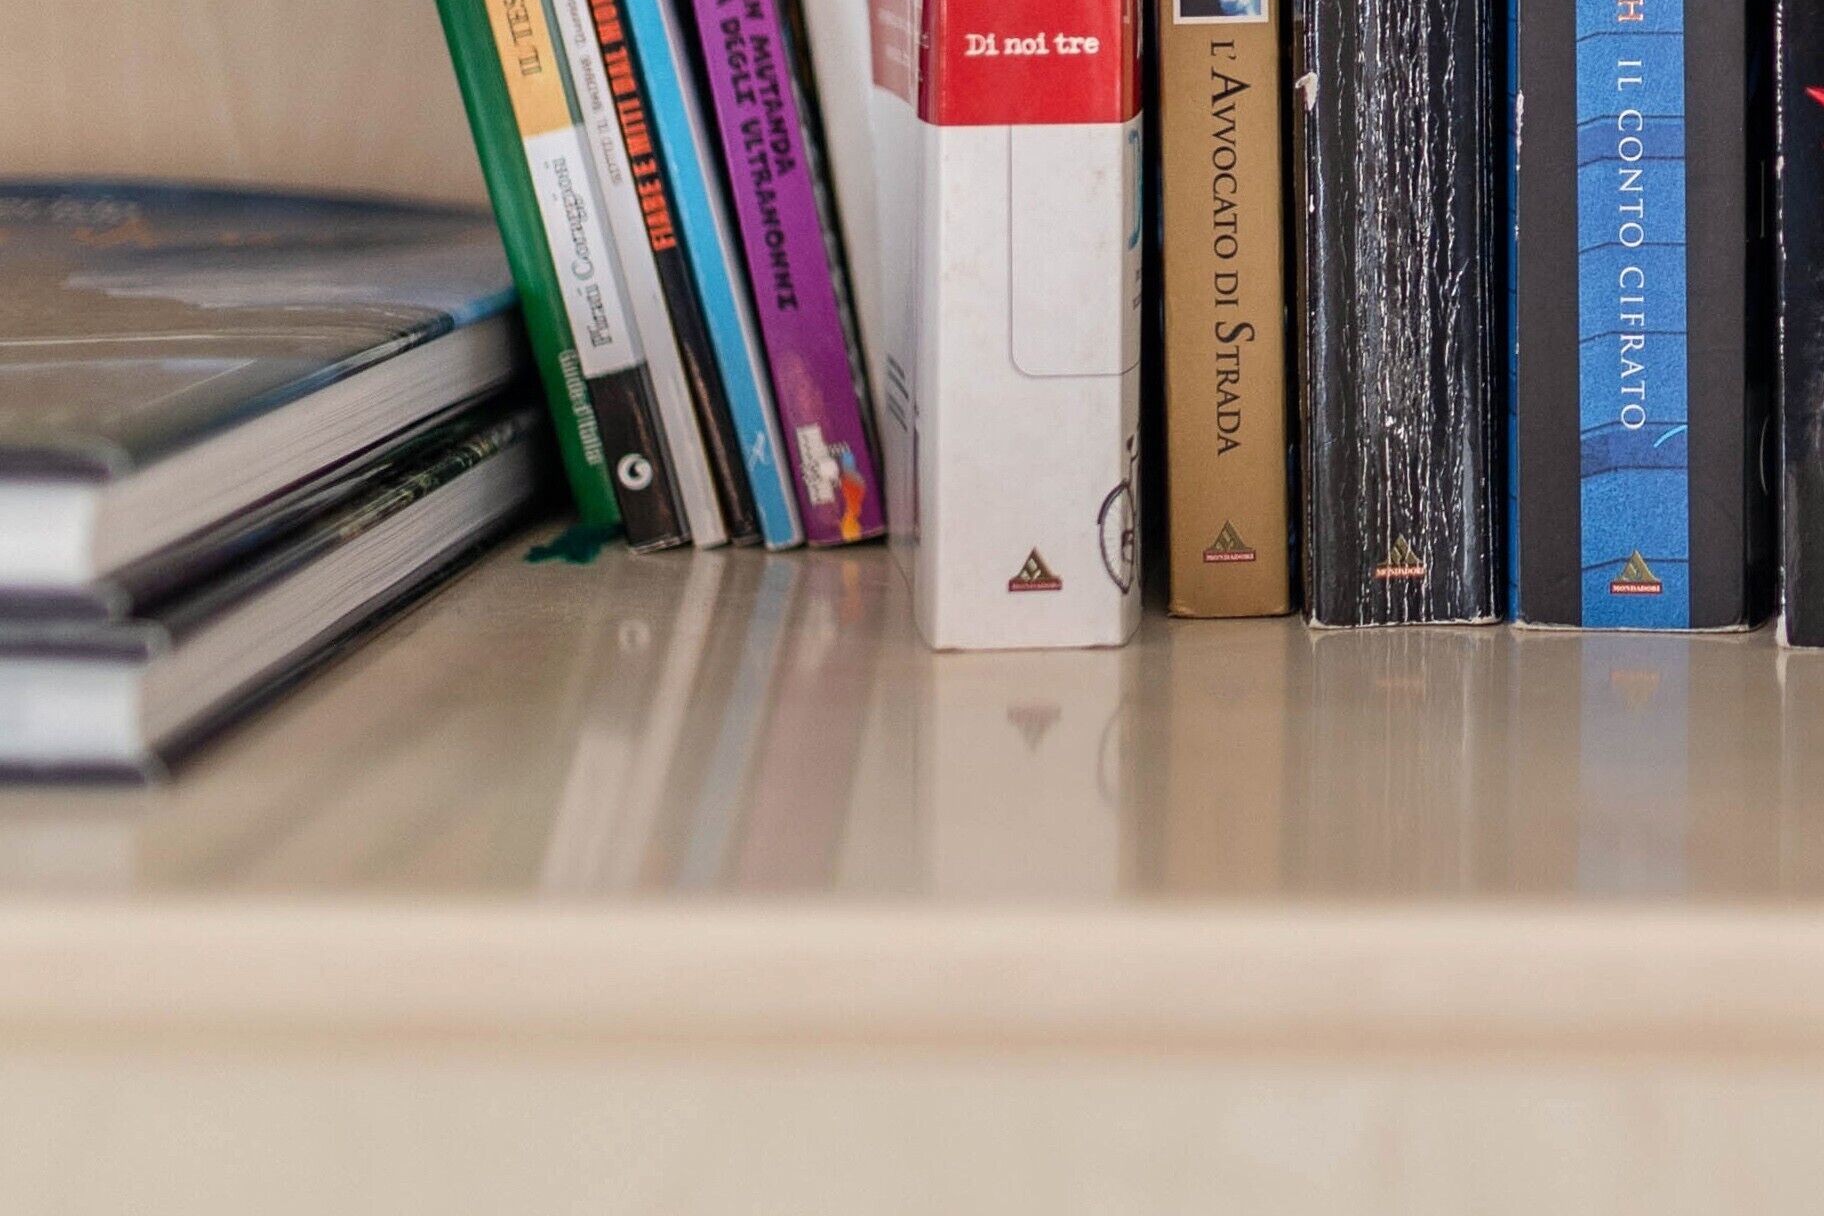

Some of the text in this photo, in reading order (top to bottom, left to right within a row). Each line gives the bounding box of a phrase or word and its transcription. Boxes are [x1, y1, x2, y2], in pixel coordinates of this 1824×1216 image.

[515, 46, 543, 78] IL
[718, 15, 757, 108] DEGLI
[965, 34, 1100, 55] Di noi tre
[1617, 60, 1642, 92] IL
[747, 31, 797, 177] MUTANDA
[1211, 69, 1252, 259] AVVOCATO
[1617, 109, 1645, 248] CONTO
[1215, 273, 1239, 308] DI
[1216, 320, 1255, 457] STRADA
[1617, 265, 1647, 432] CIFRATO
[1613, 585, 1660, 593] MONDADORI
